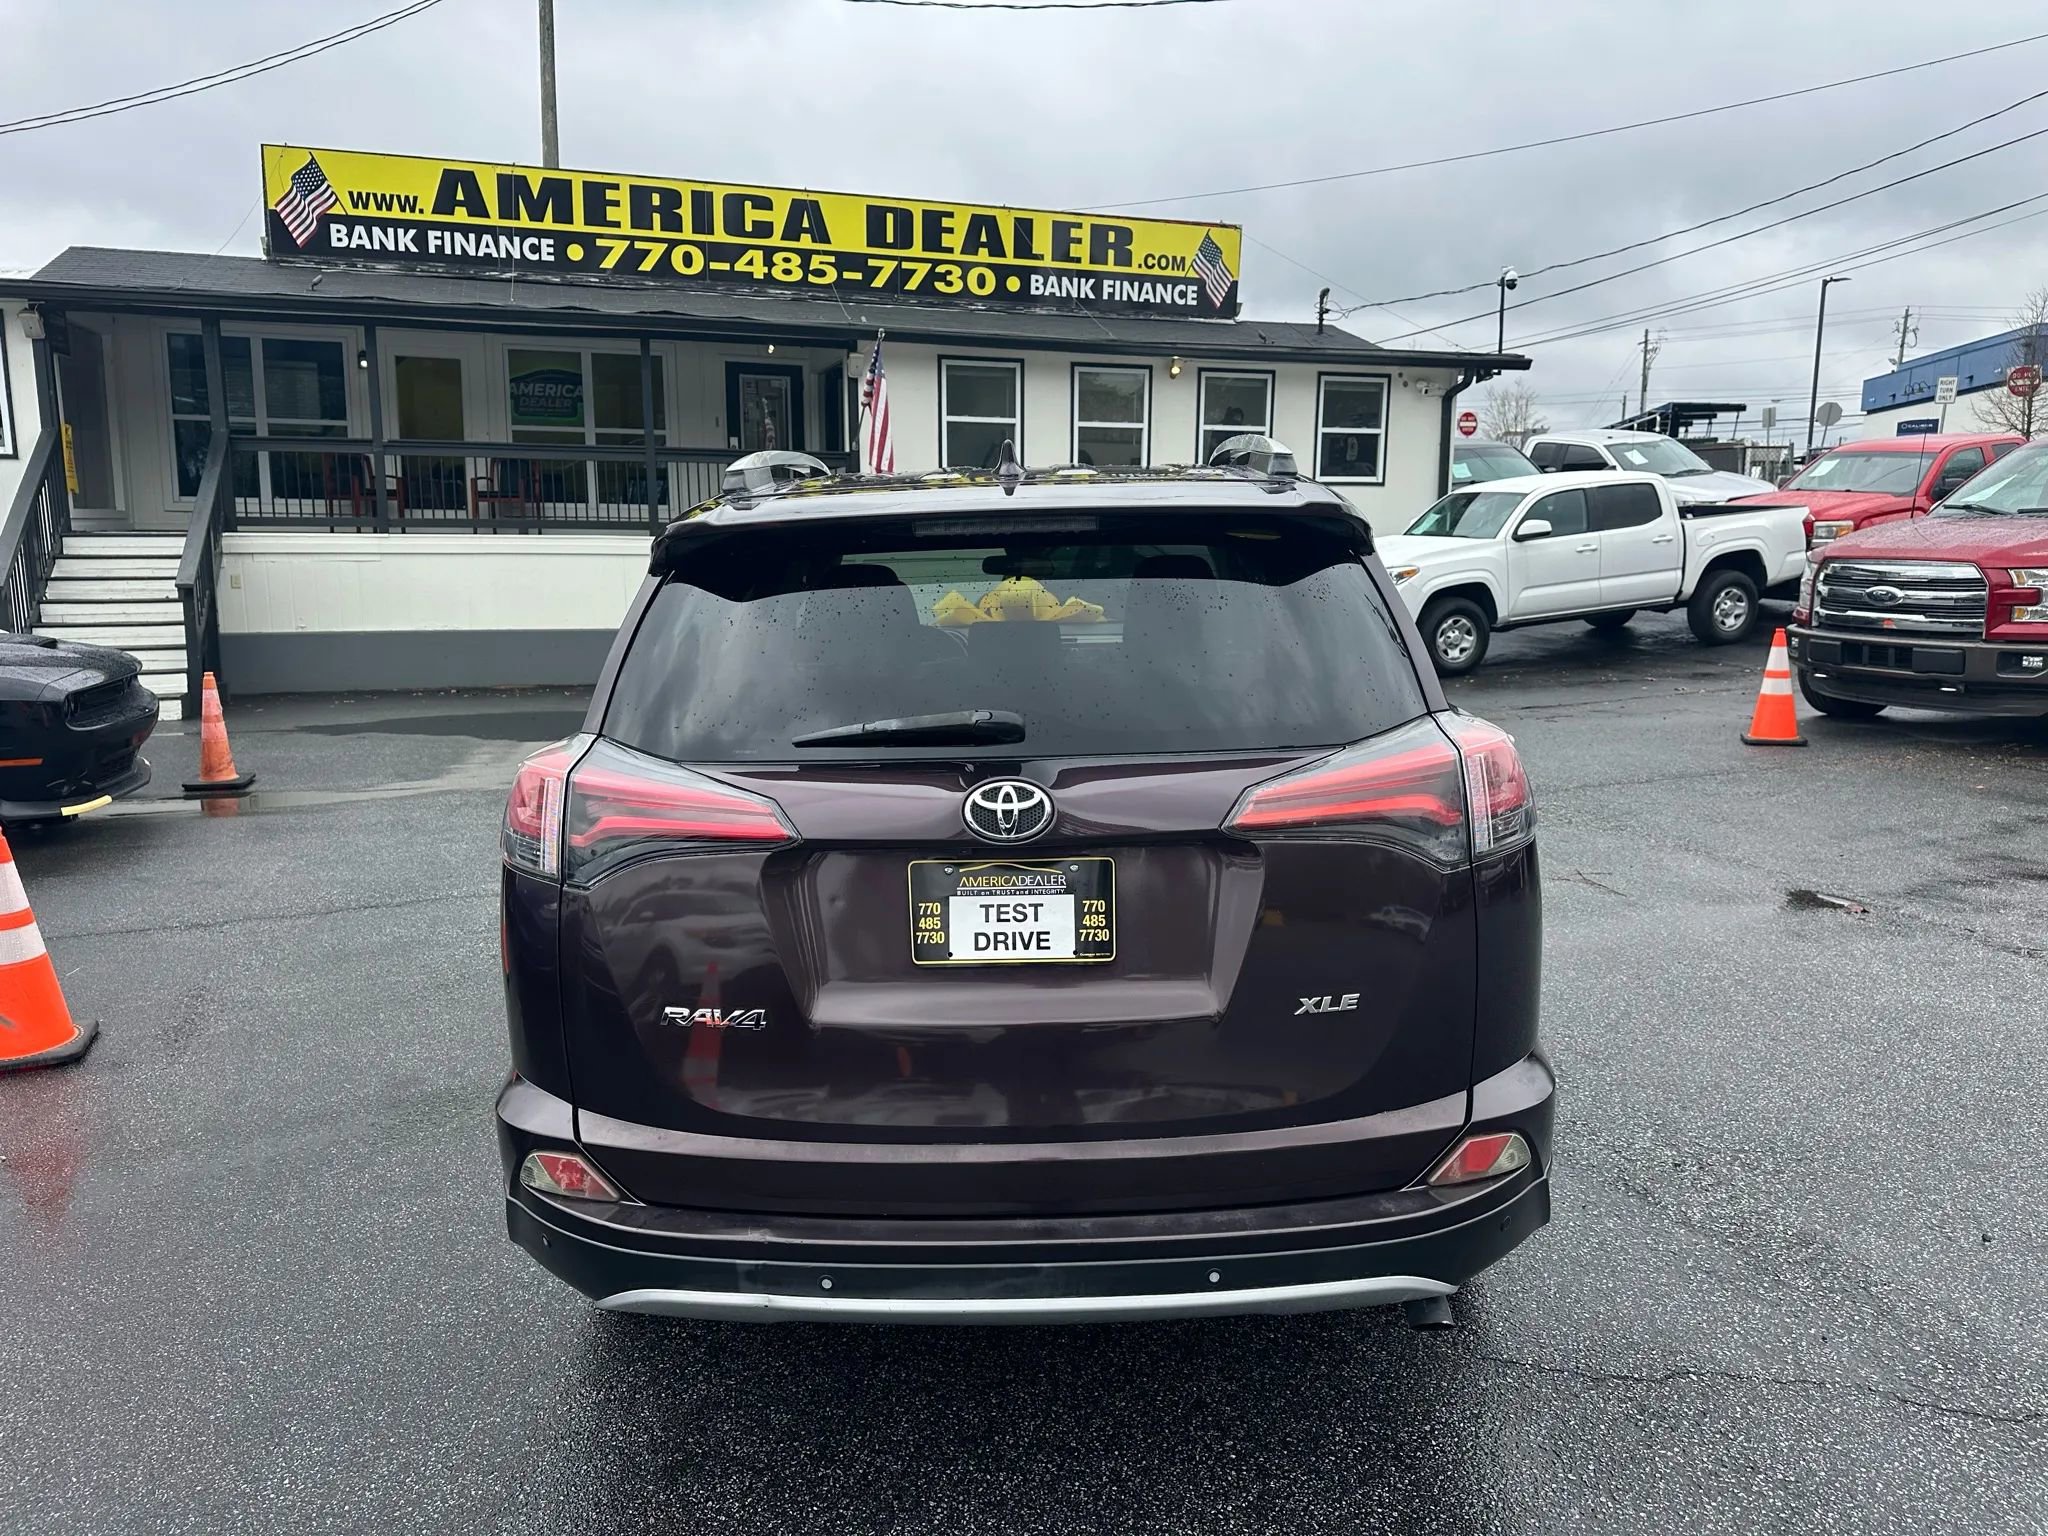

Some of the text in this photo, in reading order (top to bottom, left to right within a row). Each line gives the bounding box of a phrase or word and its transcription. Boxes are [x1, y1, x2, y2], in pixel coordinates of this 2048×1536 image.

[348, 190, 424, 214] www.
[431, 168, 831, 245] AMERICA
[866, 204, 1133, 266] DEALER
[330, 222, 1198, 305] BANK FINANCE 770-485-7730 BANK FINANCE
[510, 383, 583, 397] AMERICA
[918, 902, 941, 915] 770
[979, 903, 1044, 923] TEST
[1082, 900, 1105, 912] 770
[918, 917, 941, 929] 485
[1082, 915, 1106, 927] 485
[916, 931, 945, 944] 7730
[974, 930, 1051, 951] DRIVE
[1079, 929, 1110, 942] 7730
[1294, 993, 1360, 1015] XLE
[660, 1006, 766, 1031] RAV4
